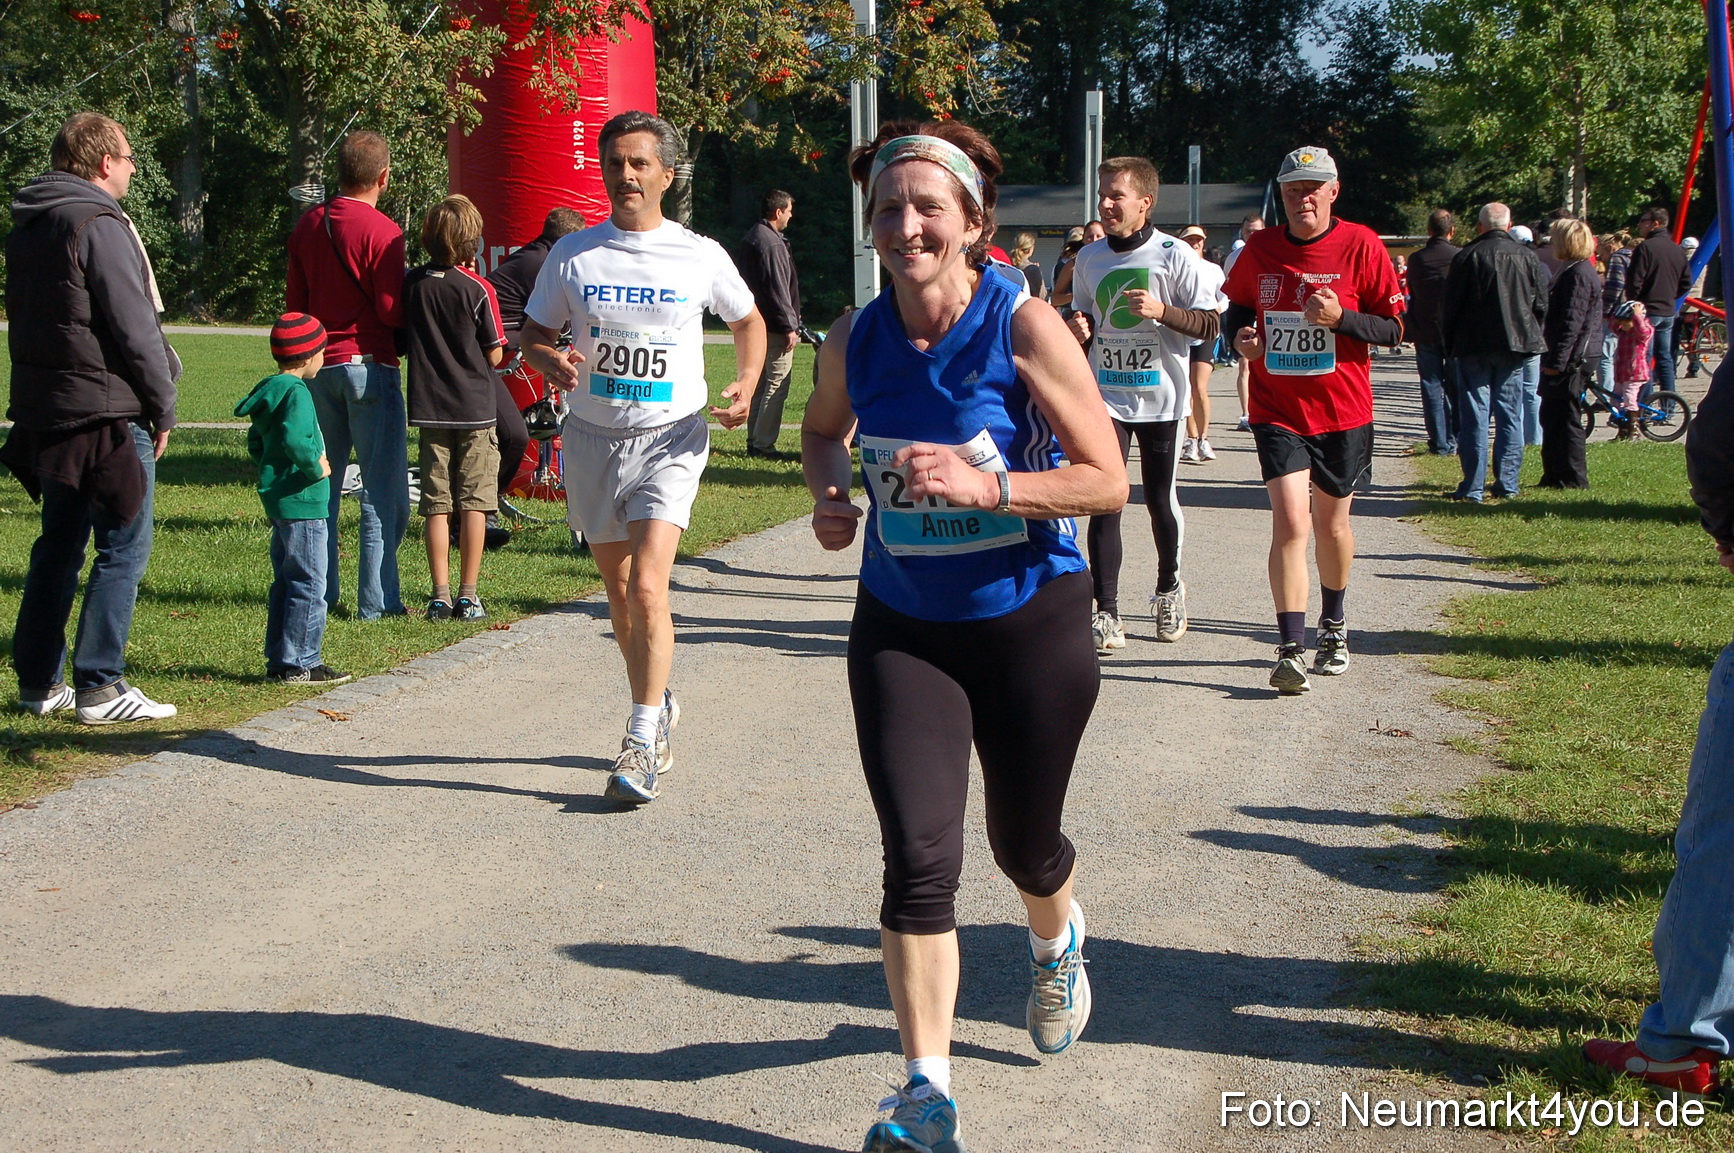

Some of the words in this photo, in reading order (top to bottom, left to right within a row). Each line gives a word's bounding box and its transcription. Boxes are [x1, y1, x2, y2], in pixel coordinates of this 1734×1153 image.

[573, 120, 584, 146] 1929
[573, 150, 584, 170] Seit
[583, 284, 656, 305] PETER
[1260, 290, 1276, 298] NEU
[597, 303, 662, 313] electronic
[1273, 316, 1300, 324] PFLEIDERER
[601, 328, 639, 339] PFLEIDERER
[1272, 328, 1326, 352] 2788
[597, 343, 667, 379] 2905
[1102, 348, 1152, 370] 3142
[1278, 354, 1318, 367] Hubert
[1106, 371, 1151, 384] Ladislav
[606, 378, 652, 398] Bernd
[922, 513, 980, 537] Anne
